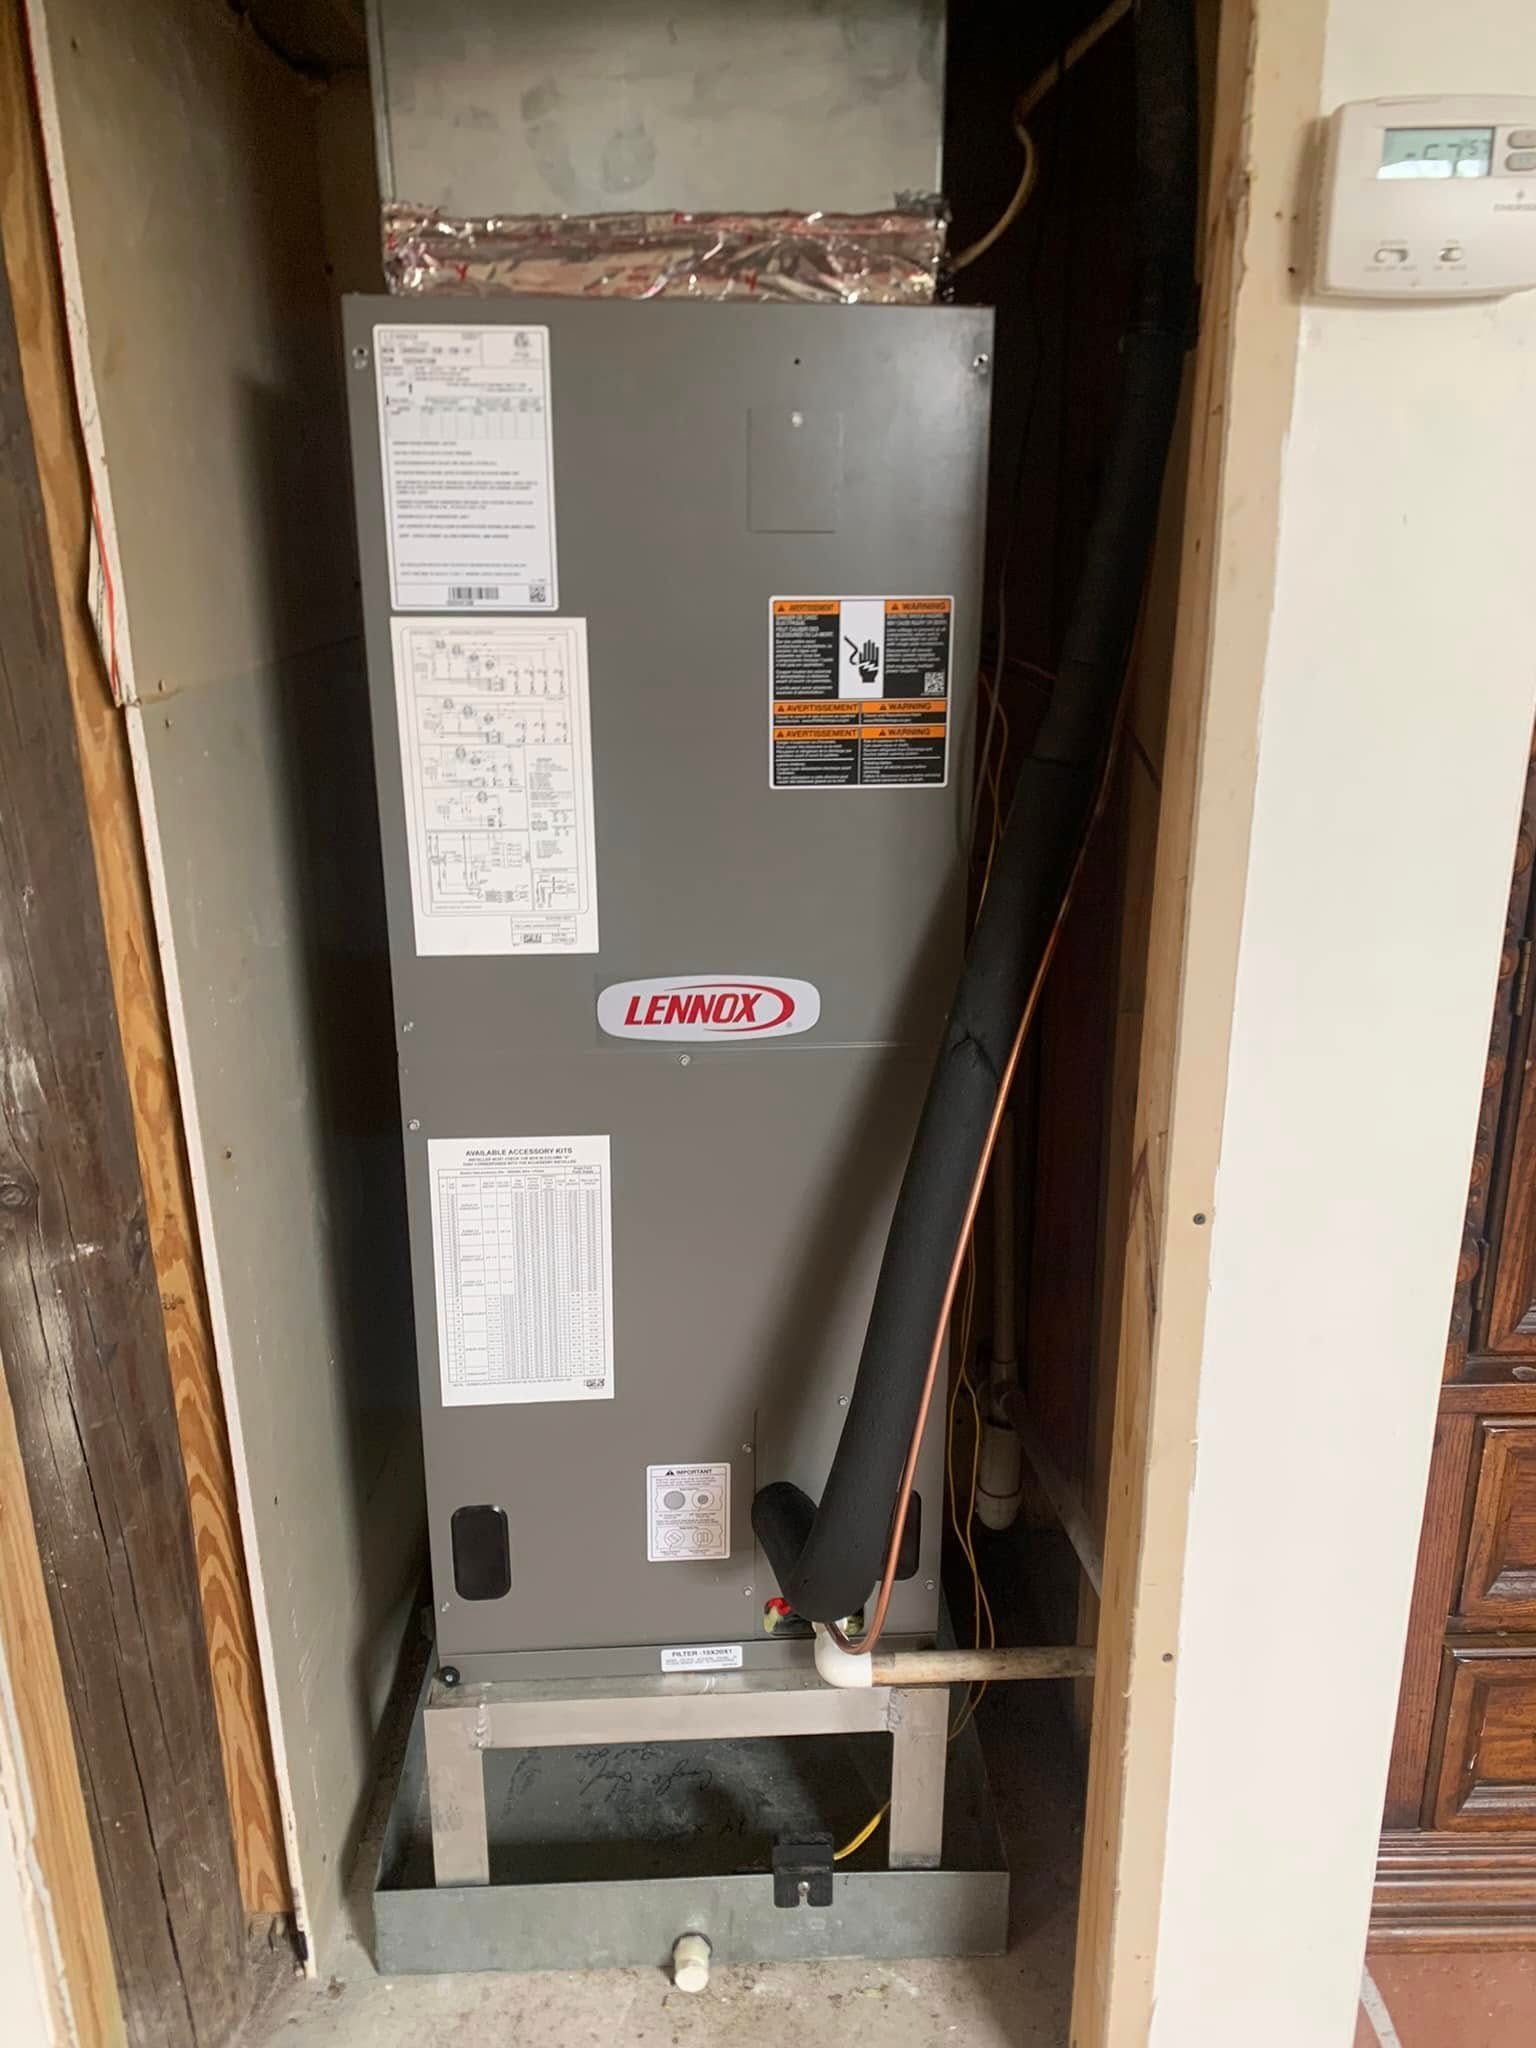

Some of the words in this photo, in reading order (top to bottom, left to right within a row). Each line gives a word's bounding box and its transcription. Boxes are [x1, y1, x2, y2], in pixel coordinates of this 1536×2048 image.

[786, 703, 857, 712] AVERTISSEMENT
[888, 703, 932, 711] WARNING
[786, 729, 857, 738] AVERTISSEMENT
[887, 728, 931, 736] WARNING
[624, 993, 762, 1026] LENNOX
[508, 1147, 554, 1155] ACCESSORY
